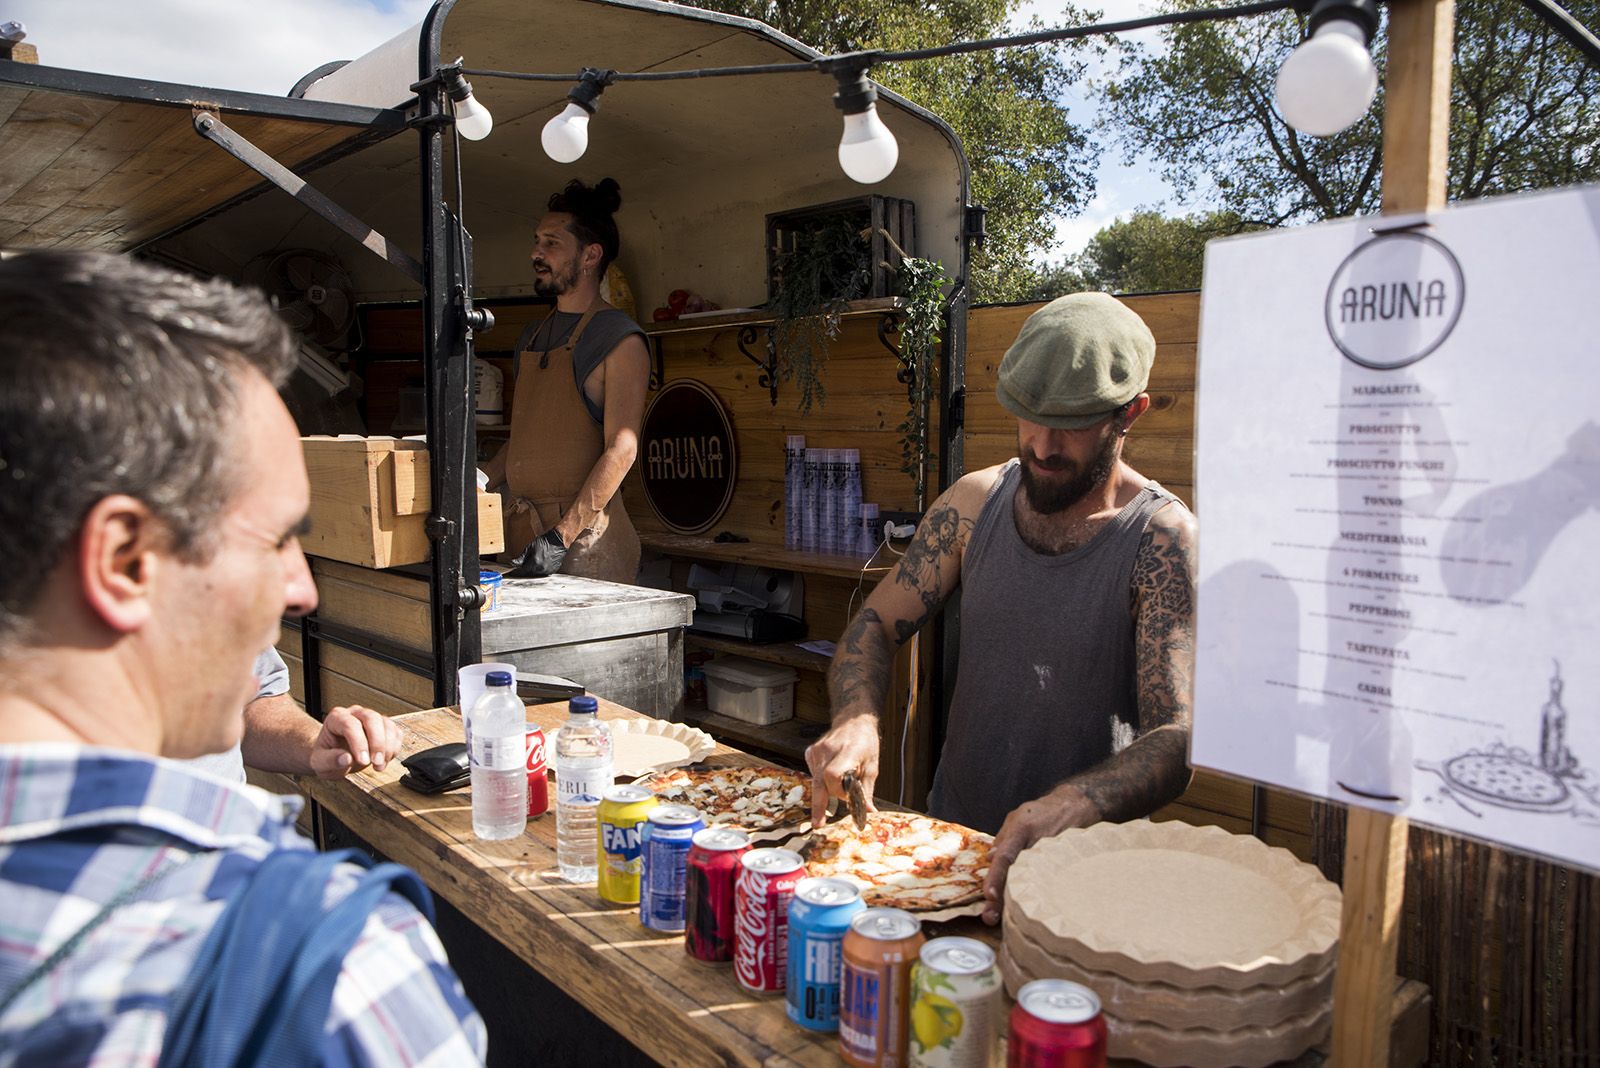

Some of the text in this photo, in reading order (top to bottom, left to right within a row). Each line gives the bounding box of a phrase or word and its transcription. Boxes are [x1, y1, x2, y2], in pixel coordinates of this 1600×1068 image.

[1340, 279, 1447, 322] ARUNA
[1352, 384, 1421, 396] MARGARITA
[1348, 424, 1422, 435] PROSCIUTTO
[648, 435, 723, 481] ARUNA
[1327, 458, 1396, 470] PROSCIUTTO
[1363, 495, 1403, 507] TONNO
[1348, 602, 1412, 620] PEPPERONI
[602, 822, 642, 850] FAN
